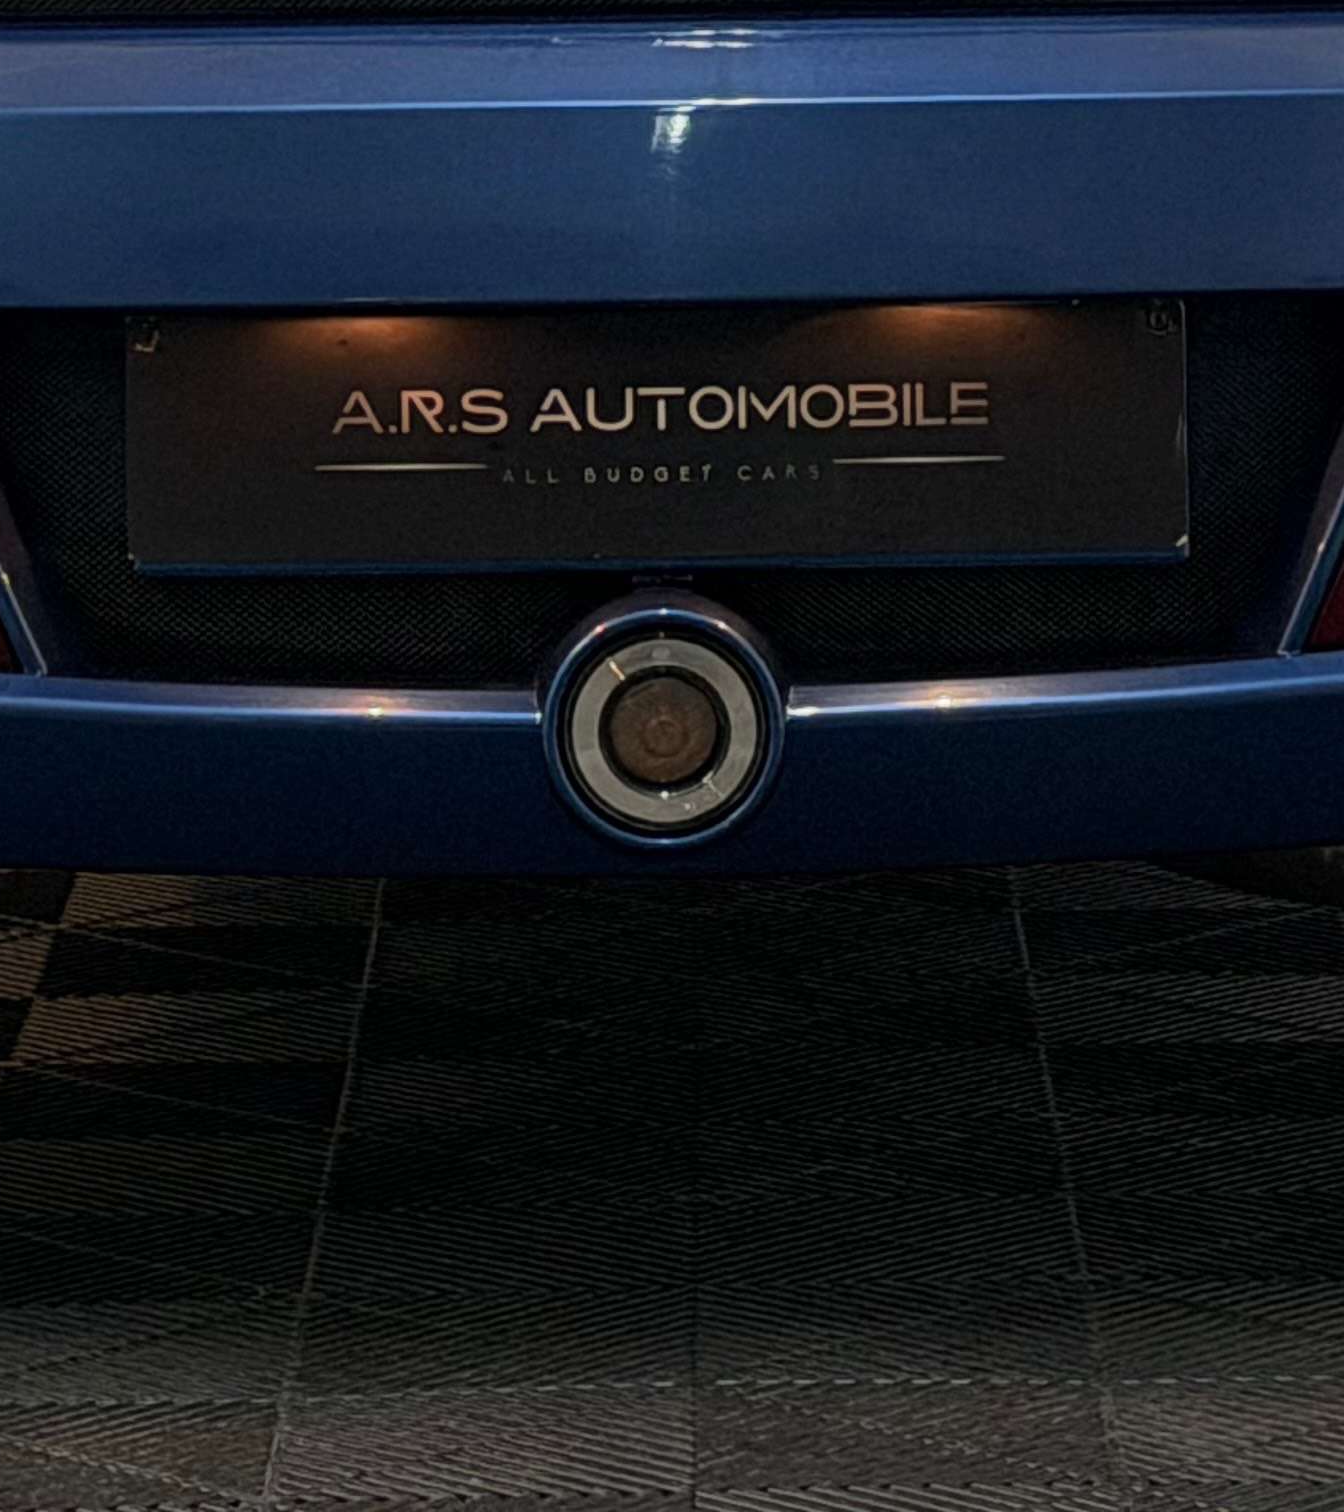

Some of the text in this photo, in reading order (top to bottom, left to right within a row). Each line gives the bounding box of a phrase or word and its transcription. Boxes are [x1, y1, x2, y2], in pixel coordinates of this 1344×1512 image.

[331, 382, 989, 434] A.R.S AUTOMOBILE
[502, 463, 822, 485] ALL BUDGET CARS
